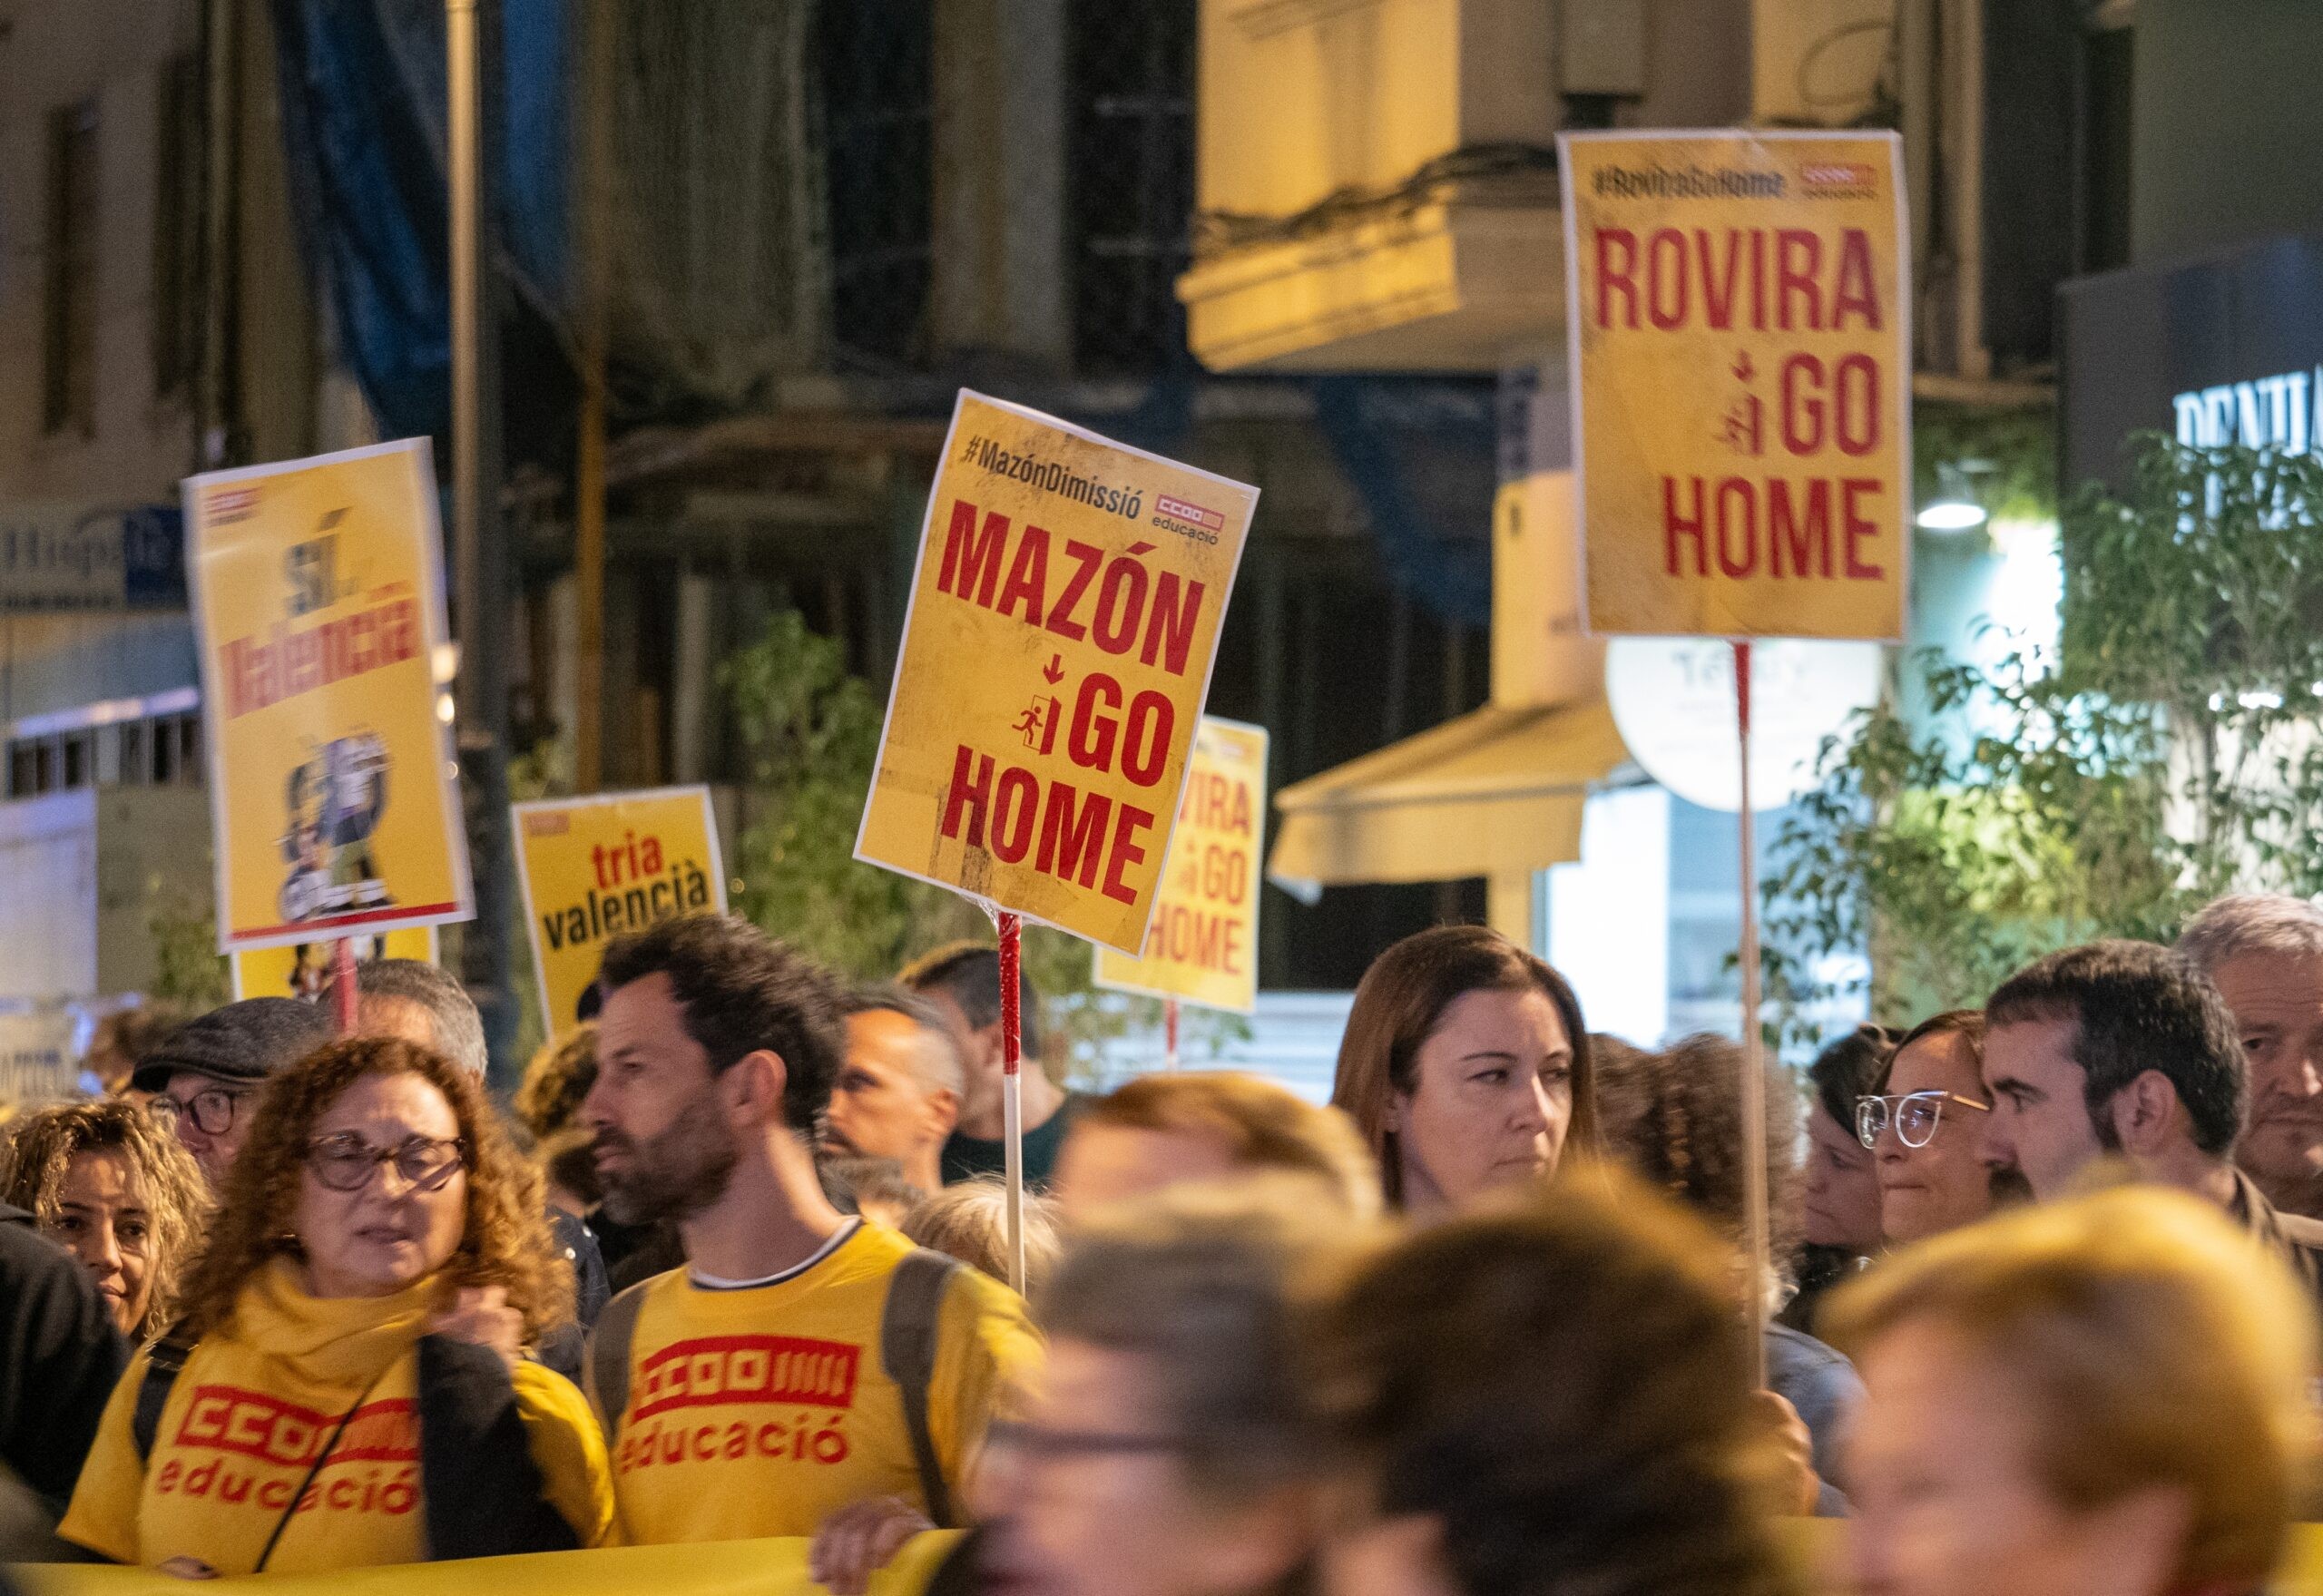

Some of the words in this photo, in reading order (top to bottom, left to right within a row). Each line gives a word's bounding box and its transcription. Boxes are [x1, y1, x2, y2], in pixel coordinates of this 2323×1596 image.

[1593, 227, 1887, 332] ROVIRA
[1779, 352, 1882, 456] GO
[962, 435, 1143, 519] #MazónDimissió
[1152, 515, 1218, 544] educació
[1660, 474, 1887, 581] HOME
[937, 499, 1205, 676] MAZÓN
[1068, 672, 1175, 788] GO
[593, 829, 663, 890] tria
[941, 744, 1155, 906] HOME
[543, 858, 711, 951] valencià
[1203, 842, 1248, 906] GO
[1144, 901, 1243, 976] HOME
[155, 1458, 420, 1516] educació
[621, 1413, 849, 1474] educació
